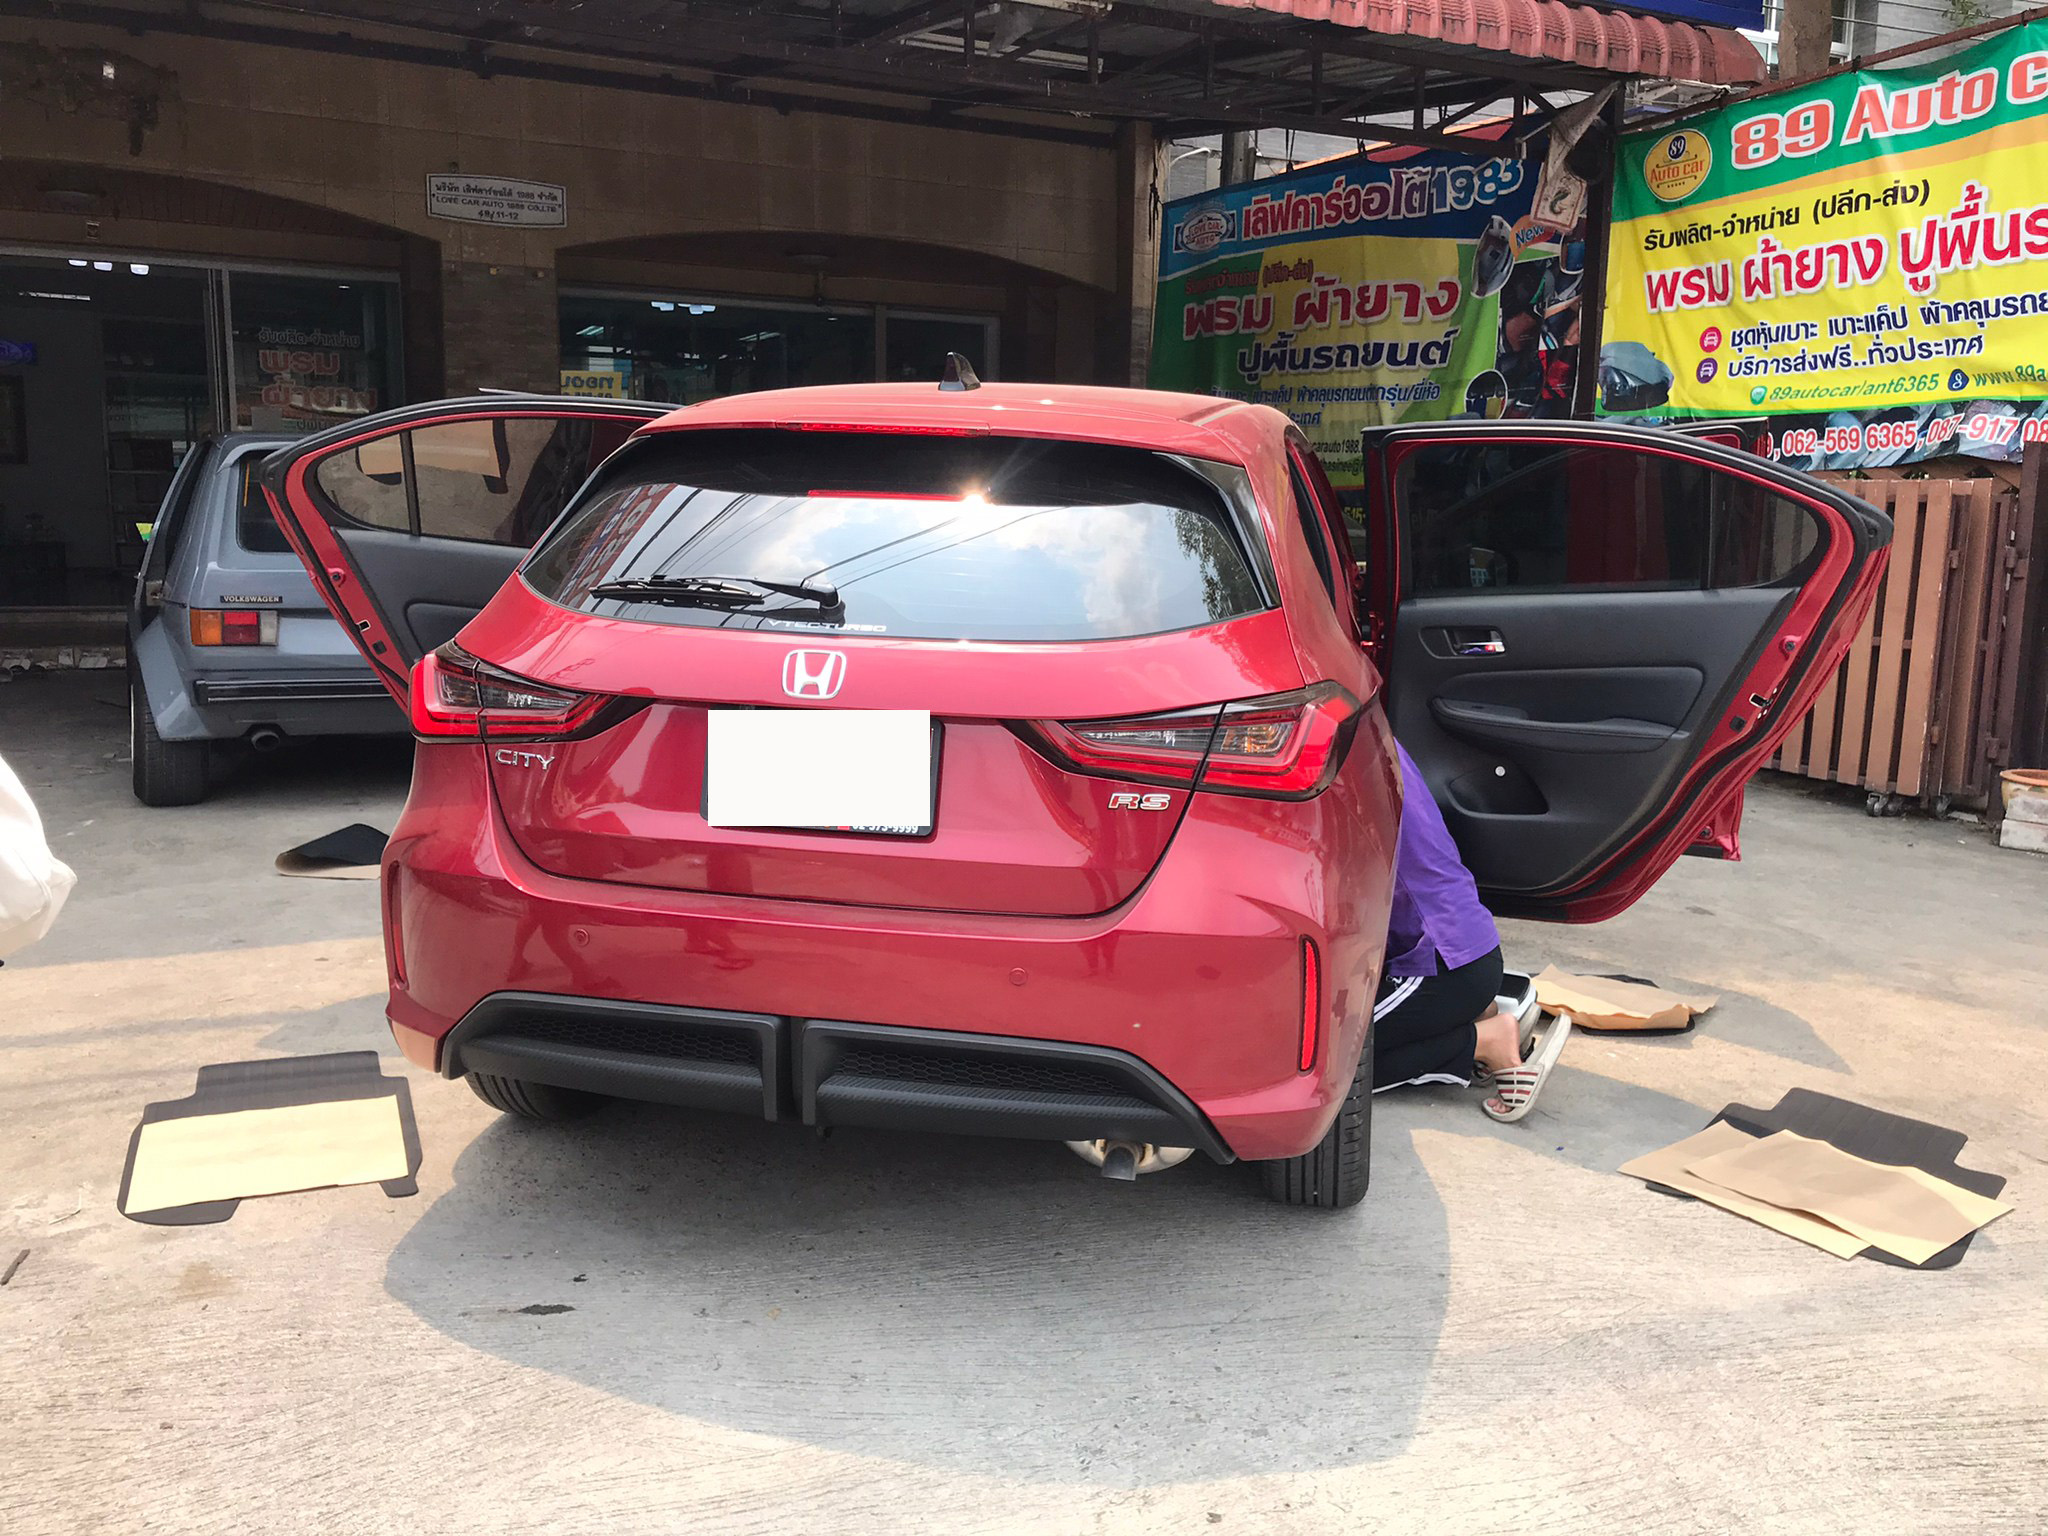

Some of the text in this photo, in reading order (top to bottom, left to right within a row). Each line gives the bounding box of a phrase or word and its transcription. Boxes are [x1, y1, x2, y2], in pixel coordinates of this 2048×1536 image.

[1731, 99, 1834, 170] 89
[1841, 68, 1999, 146] Auto
[1668, 138, 1685, 158] 89
[1650, 160, 1705, 184] Auto car
[436, 195, 459, 205] LOVE
[461, 198, 480, 207] CAR
[482, 200, 504, 209] AUTO
[1644, 179, 1931, 251] รับผลิต-จำหน่าย (ปลีก-ส่ง)
[1515, 224, 1545, 248] New
[1646, 262, 1730, 311] พรม
[1744, 236, 1884, 299] ผ้ายาง
[1185, 274, 1459, 338] พรม ผ้ายาง
[1730, 319, 1818, 352] ชุดหุ้มเบาะ
[1828, 304, 1908, 338] เบาะแค็ป
[259, 349, 340, 375] พรม
[1238, 327, 1460, 383] ปูพื้นรถยนต์
[1782, 426, 1861, 455] 062-569
[223, 595, 280, 603] VOLKSWAGEN
[495, 749, 556, 770] CITY
[1108, 792, 1171, 810] RS
